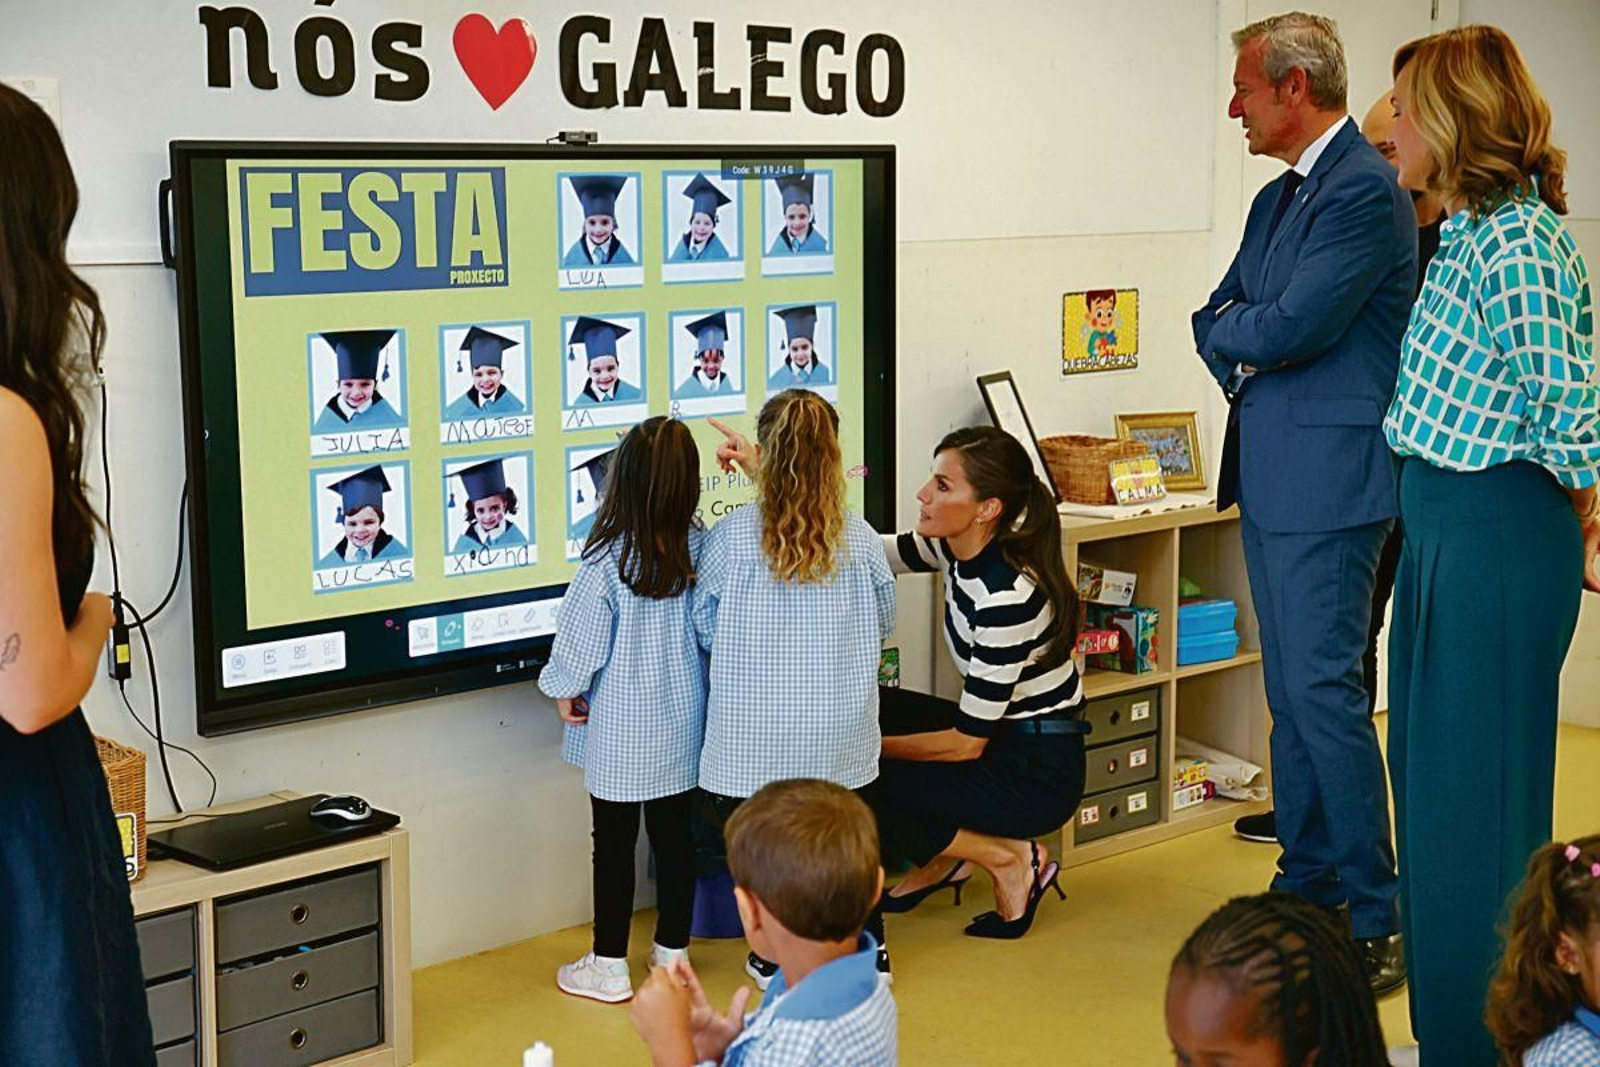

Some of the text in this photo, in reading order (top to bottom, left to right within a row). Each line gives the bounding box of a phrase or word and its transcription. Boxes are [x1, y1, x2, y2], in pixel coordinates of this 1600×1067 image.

[198, 0, 905, 118] nós GALEGO
[246, 171, 503, 273] FESTA
[450, 268, 505, 285] PROXECTO
[1063, 353, 1138, 371] QUEBRACABEZAS
[322, 428, 406, 453] JULIA
[1118, 483, 1163, 502] CALMA
[317, 560, 413, 589] LUCAS
